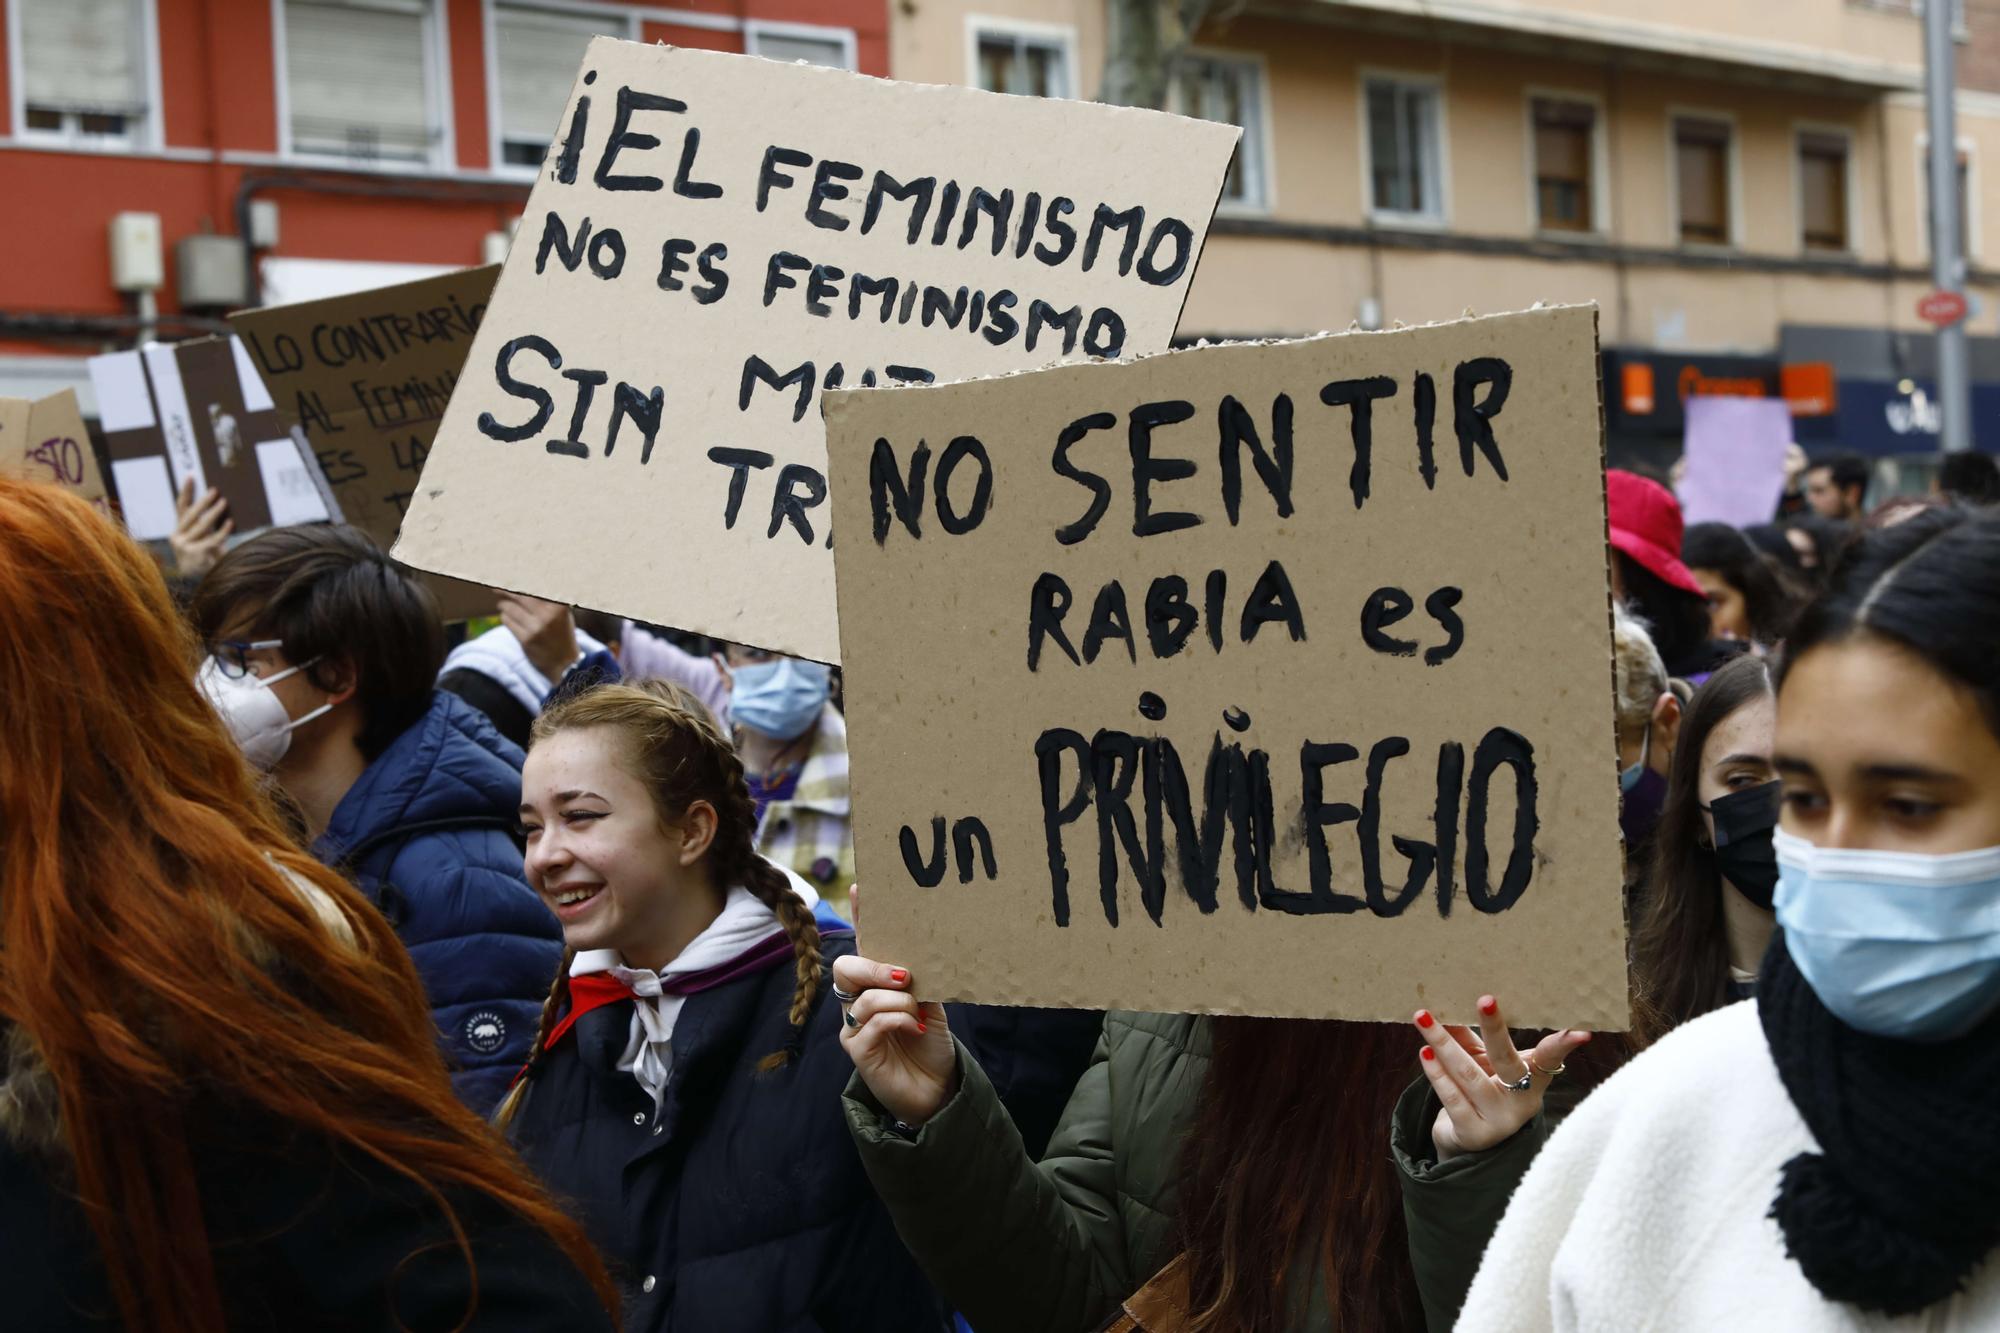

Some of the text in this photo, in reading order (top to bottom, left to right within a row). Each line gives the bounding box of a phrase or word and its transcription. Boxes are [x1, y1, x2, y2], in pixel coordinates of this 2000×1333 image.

[756, 145, 1193, 286] FEMINISMO
[535, 211, 1126, 359] NO ES FEMINISMO
[248, 329, 304, 375] LO
[478, 335, 665, 465] SIN
[296, 390, 344, 437] AL
[320, 450, 368, 485] ES
[391, 435, 431, 475] LA
[869, 437, 993, 547] NO
[1052, 357, 1513, 545] SENTIR
[707, 446, 833, 550] TR
[1027, 559, 1465, 673] RABIA es
[899, 815, 998, 888] un
